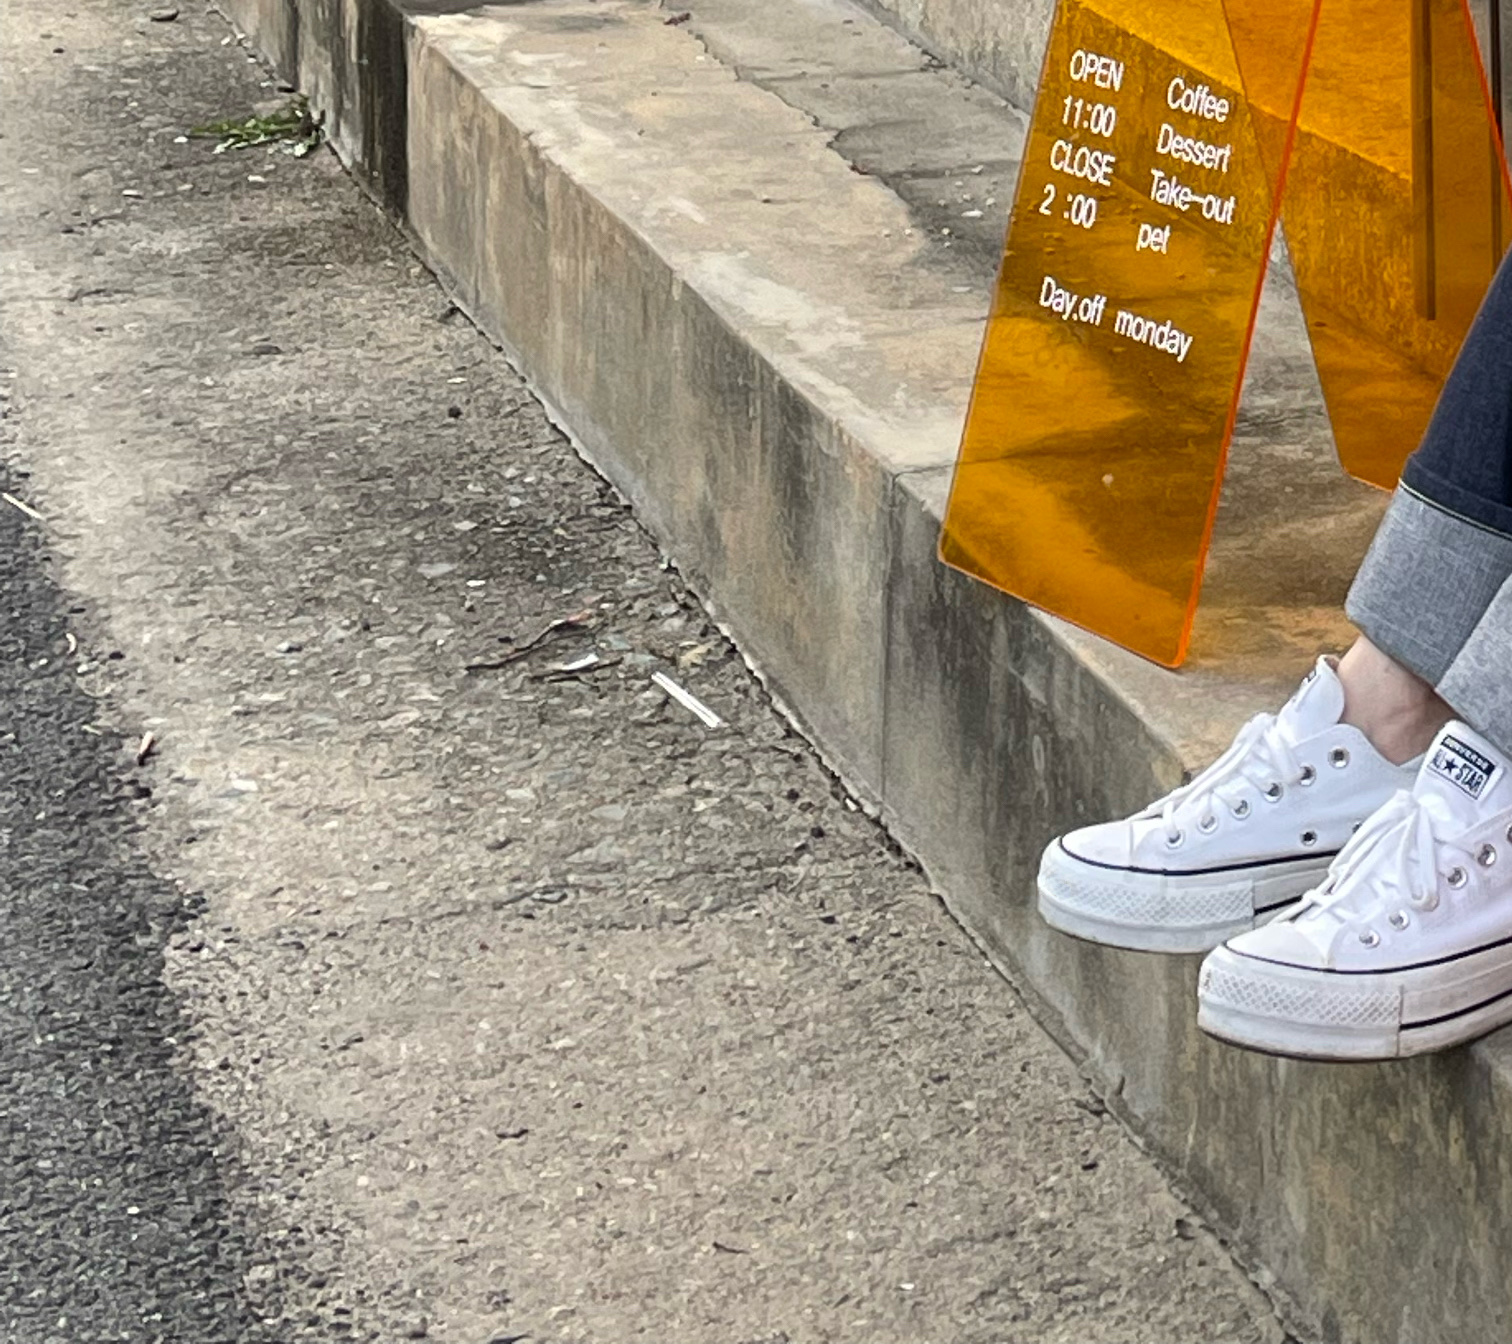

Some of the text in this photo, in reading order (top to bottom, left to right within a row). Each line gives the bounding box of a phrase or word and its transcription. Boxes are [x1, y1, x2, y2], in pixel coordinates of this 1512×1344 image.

[1070, 48, 1124, 92] OPEN
[1061, 95, 1116, 138] 11:00
[1167, 77, 1230, 123] Coffee
[1050, 139, 1116, 187] CLOSE
[1155, 123, 1232, 173] Dessert
[1150, 168, 1236, 225] Take-out
[1136, 223, 1171, 255] pet
[1039, 275, 1194, 364] Day.off monday
[1455, 762, 1485, 793] STAR
